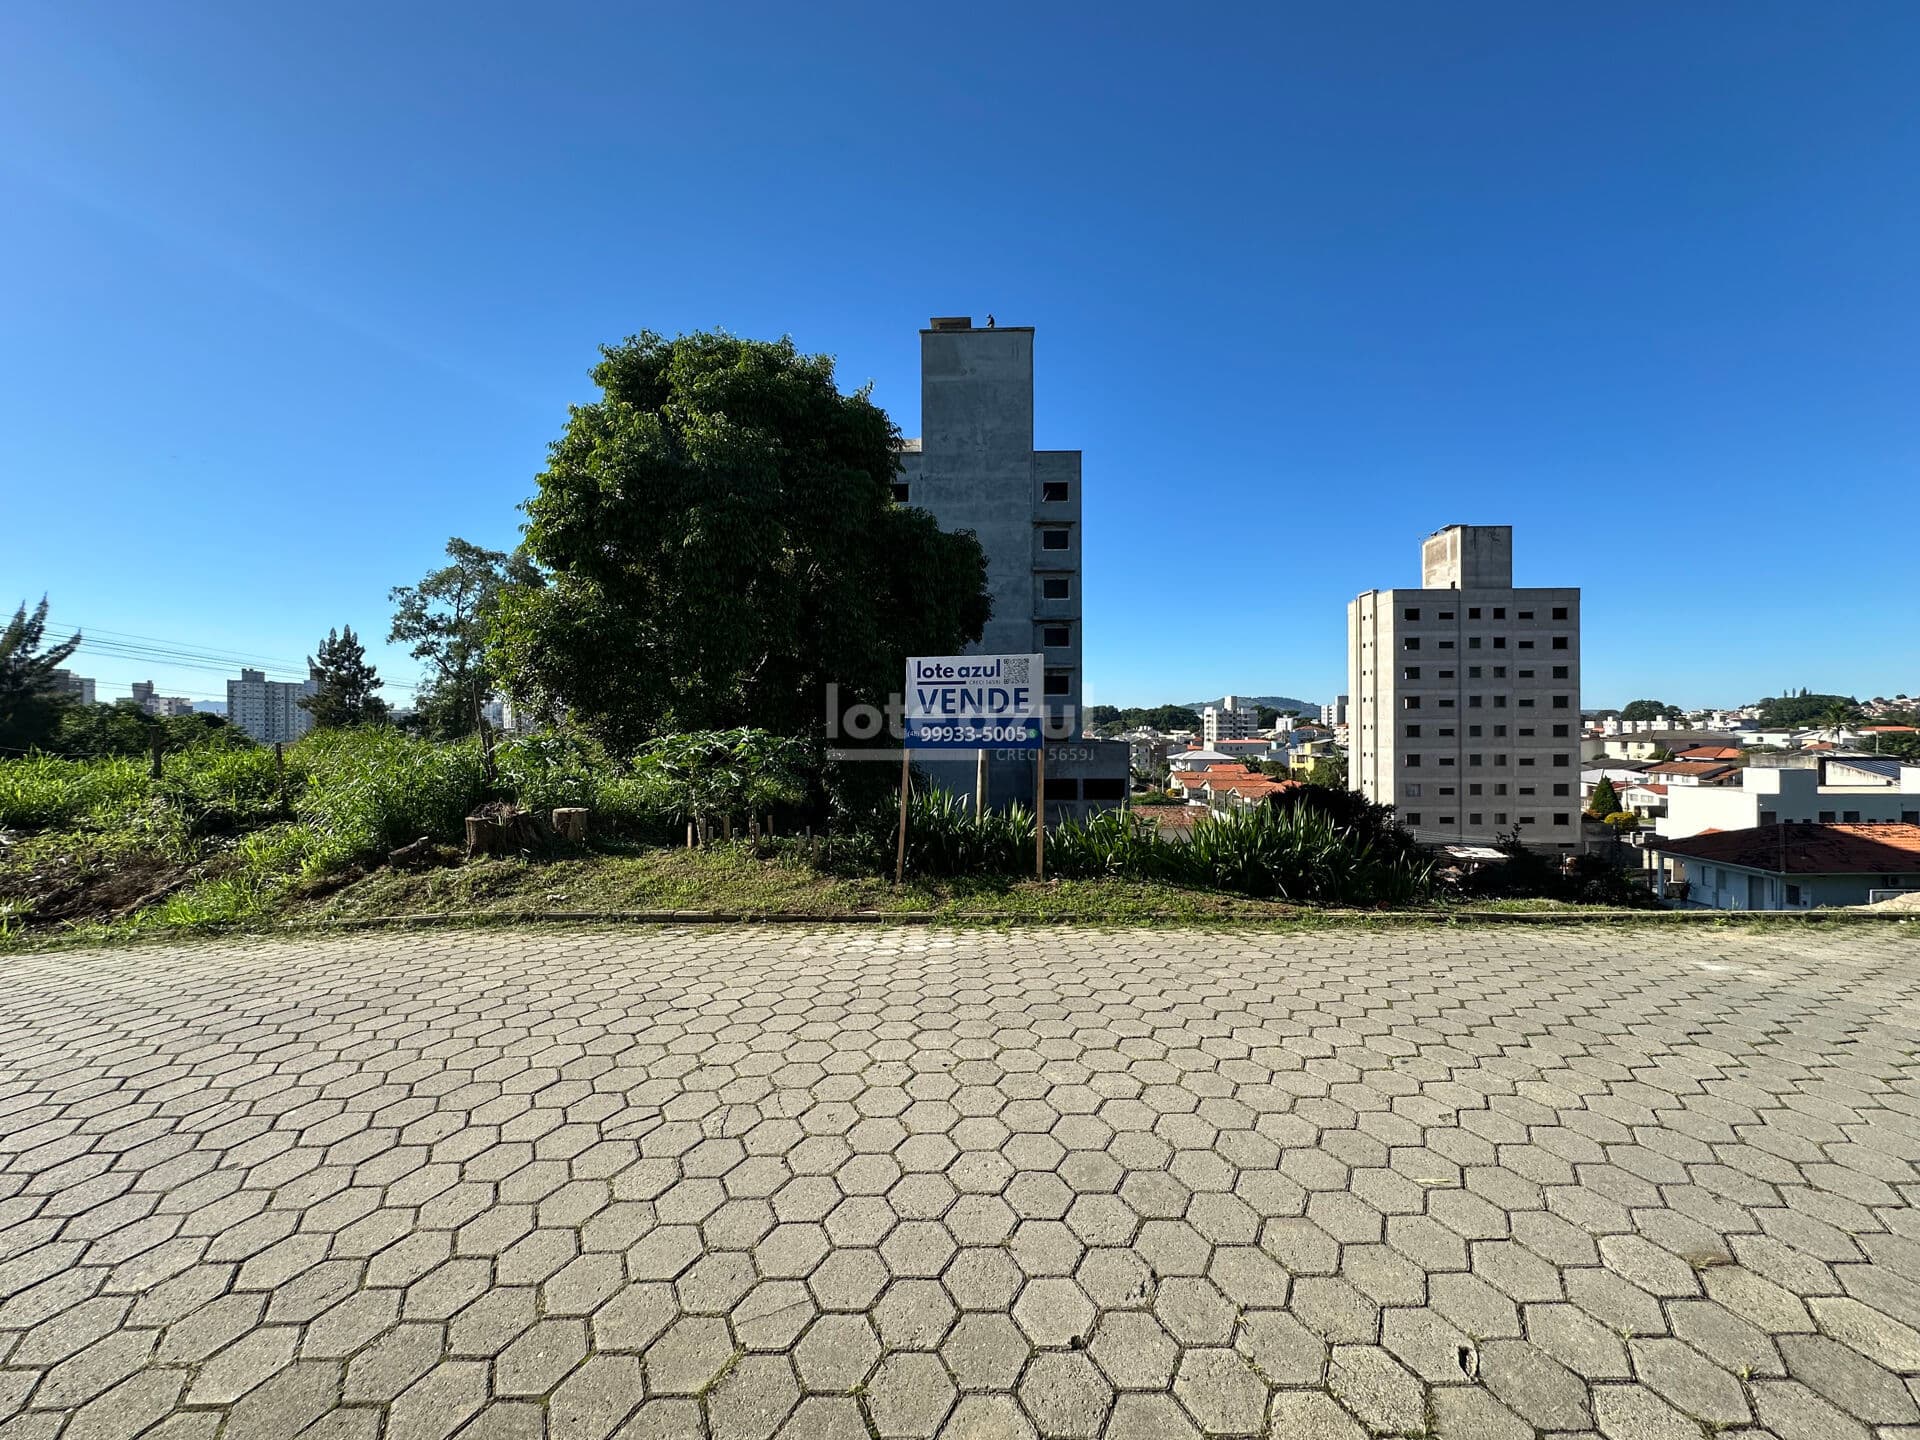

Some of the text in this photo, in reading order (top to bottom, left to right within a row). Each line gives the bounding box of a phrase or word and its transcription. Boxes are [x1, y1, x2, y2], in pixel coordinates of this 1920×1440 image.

[917, 658, 1001, 679] lote azul
[917, 687, 1030, 714] VENDE
[920, 726, 1028, 742] 99933-5005
